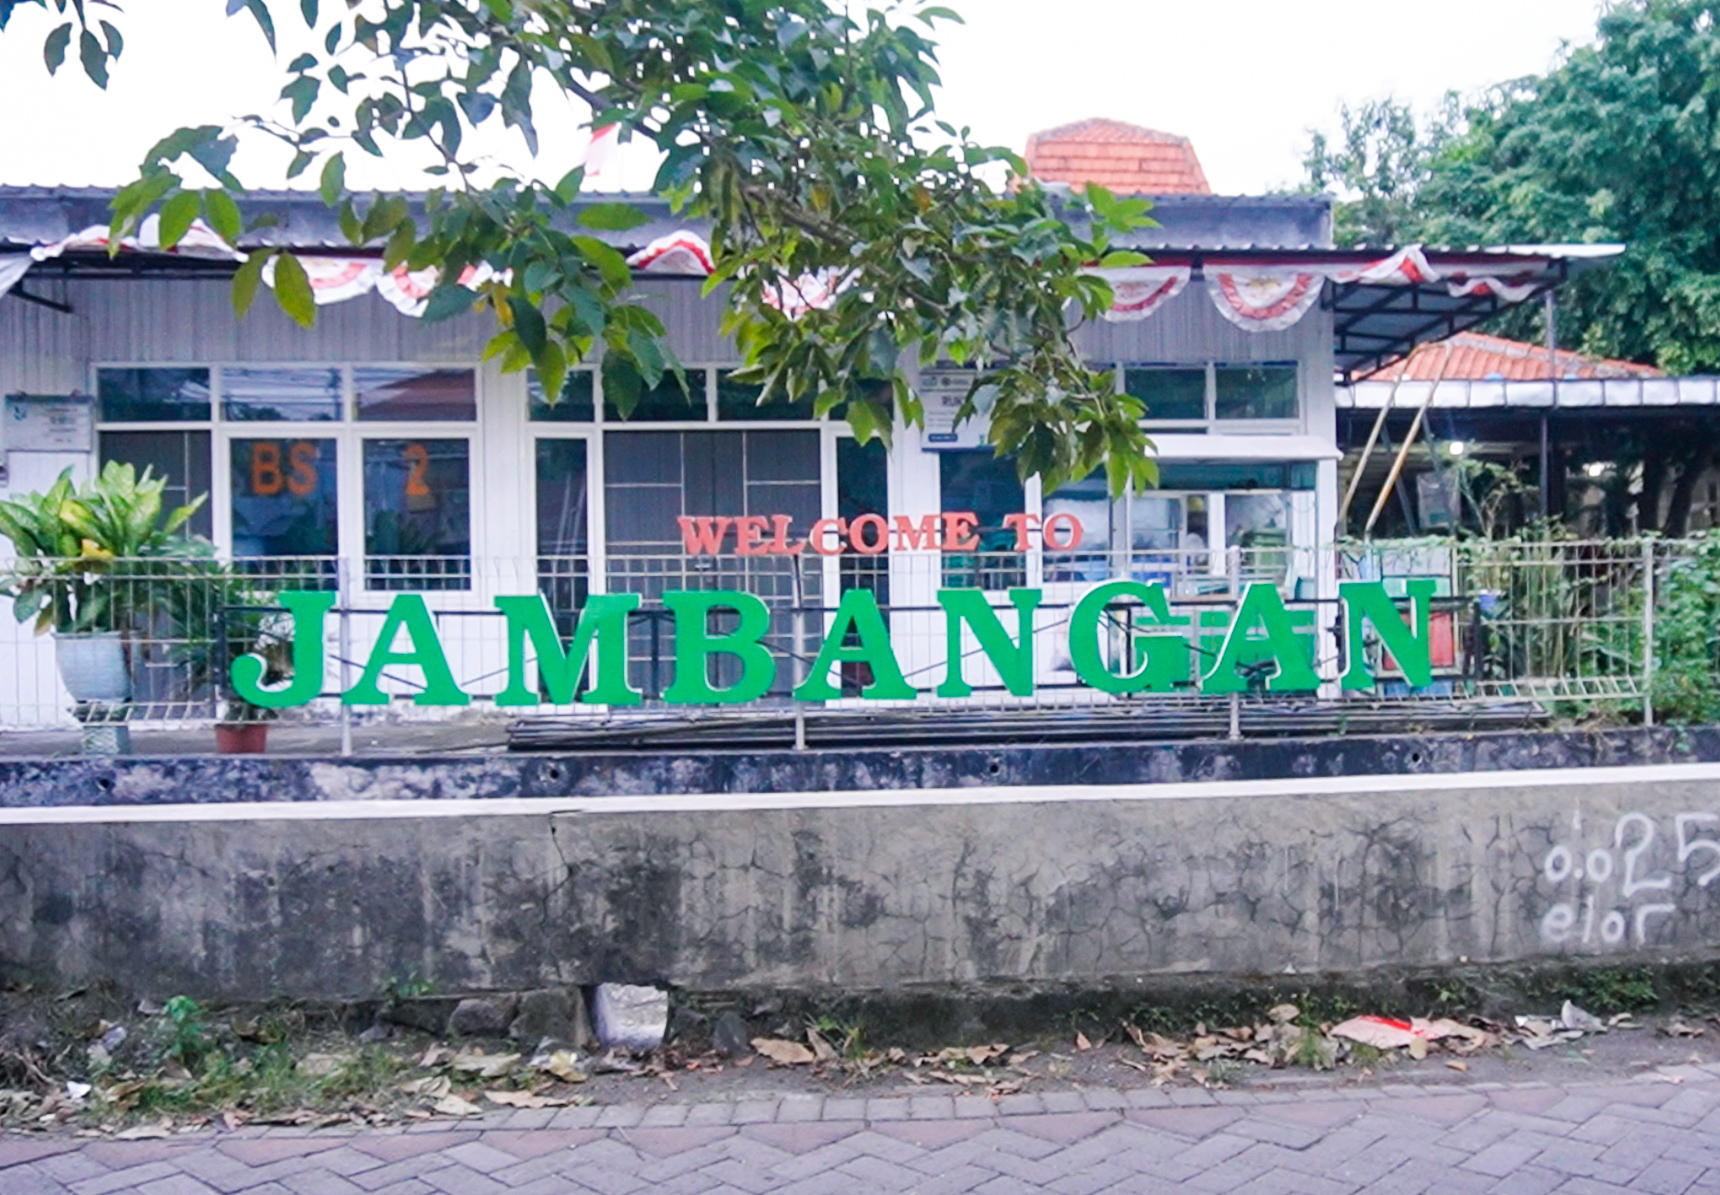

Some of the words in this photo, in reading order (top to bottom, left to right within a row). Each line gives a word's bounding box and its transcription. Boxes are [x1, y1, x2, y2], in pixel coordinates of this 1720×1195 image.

[253, 442, 317, 495] BS
[404, 444, 430, 495] 2
[678, 512, 980, 555] WELCOME
[1003, 513, 1083, 551] TO
[230, 579, 1436, 708] JAMBANGAN
